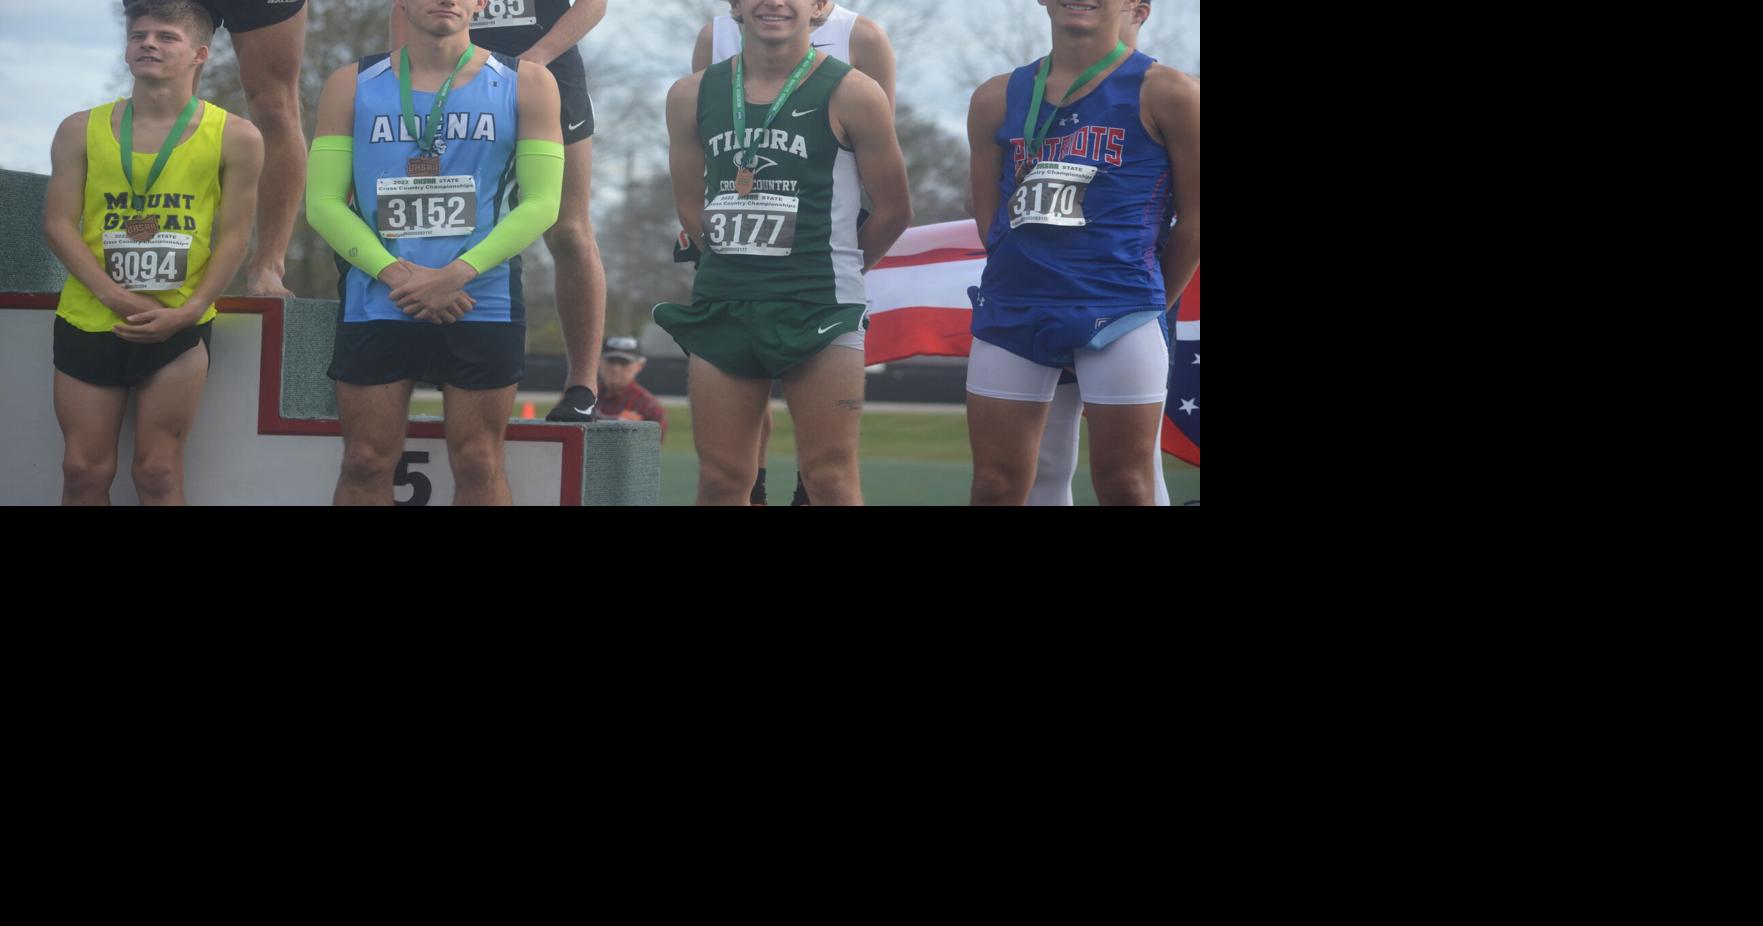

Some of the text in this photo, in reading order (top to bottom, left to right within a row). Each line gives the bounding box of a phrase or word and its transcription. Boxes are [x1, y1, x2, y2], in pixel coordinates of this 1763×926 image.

[479, 0, 524, 17] 85
[708, 128, 808, 159] TINORA
[1010, 125, 1125, 168] PATROTS
[104, 192, 194, 209] MUNT
[388, 196, 465, 227] 3152
[1013, 183, 1077, 215] 3170
[103, 213, 196, 230] GIAD
[710, 213, 785, 246] 3177
[111, 251, 177, 281] 3094
[392, 451, 432, 506] 5
